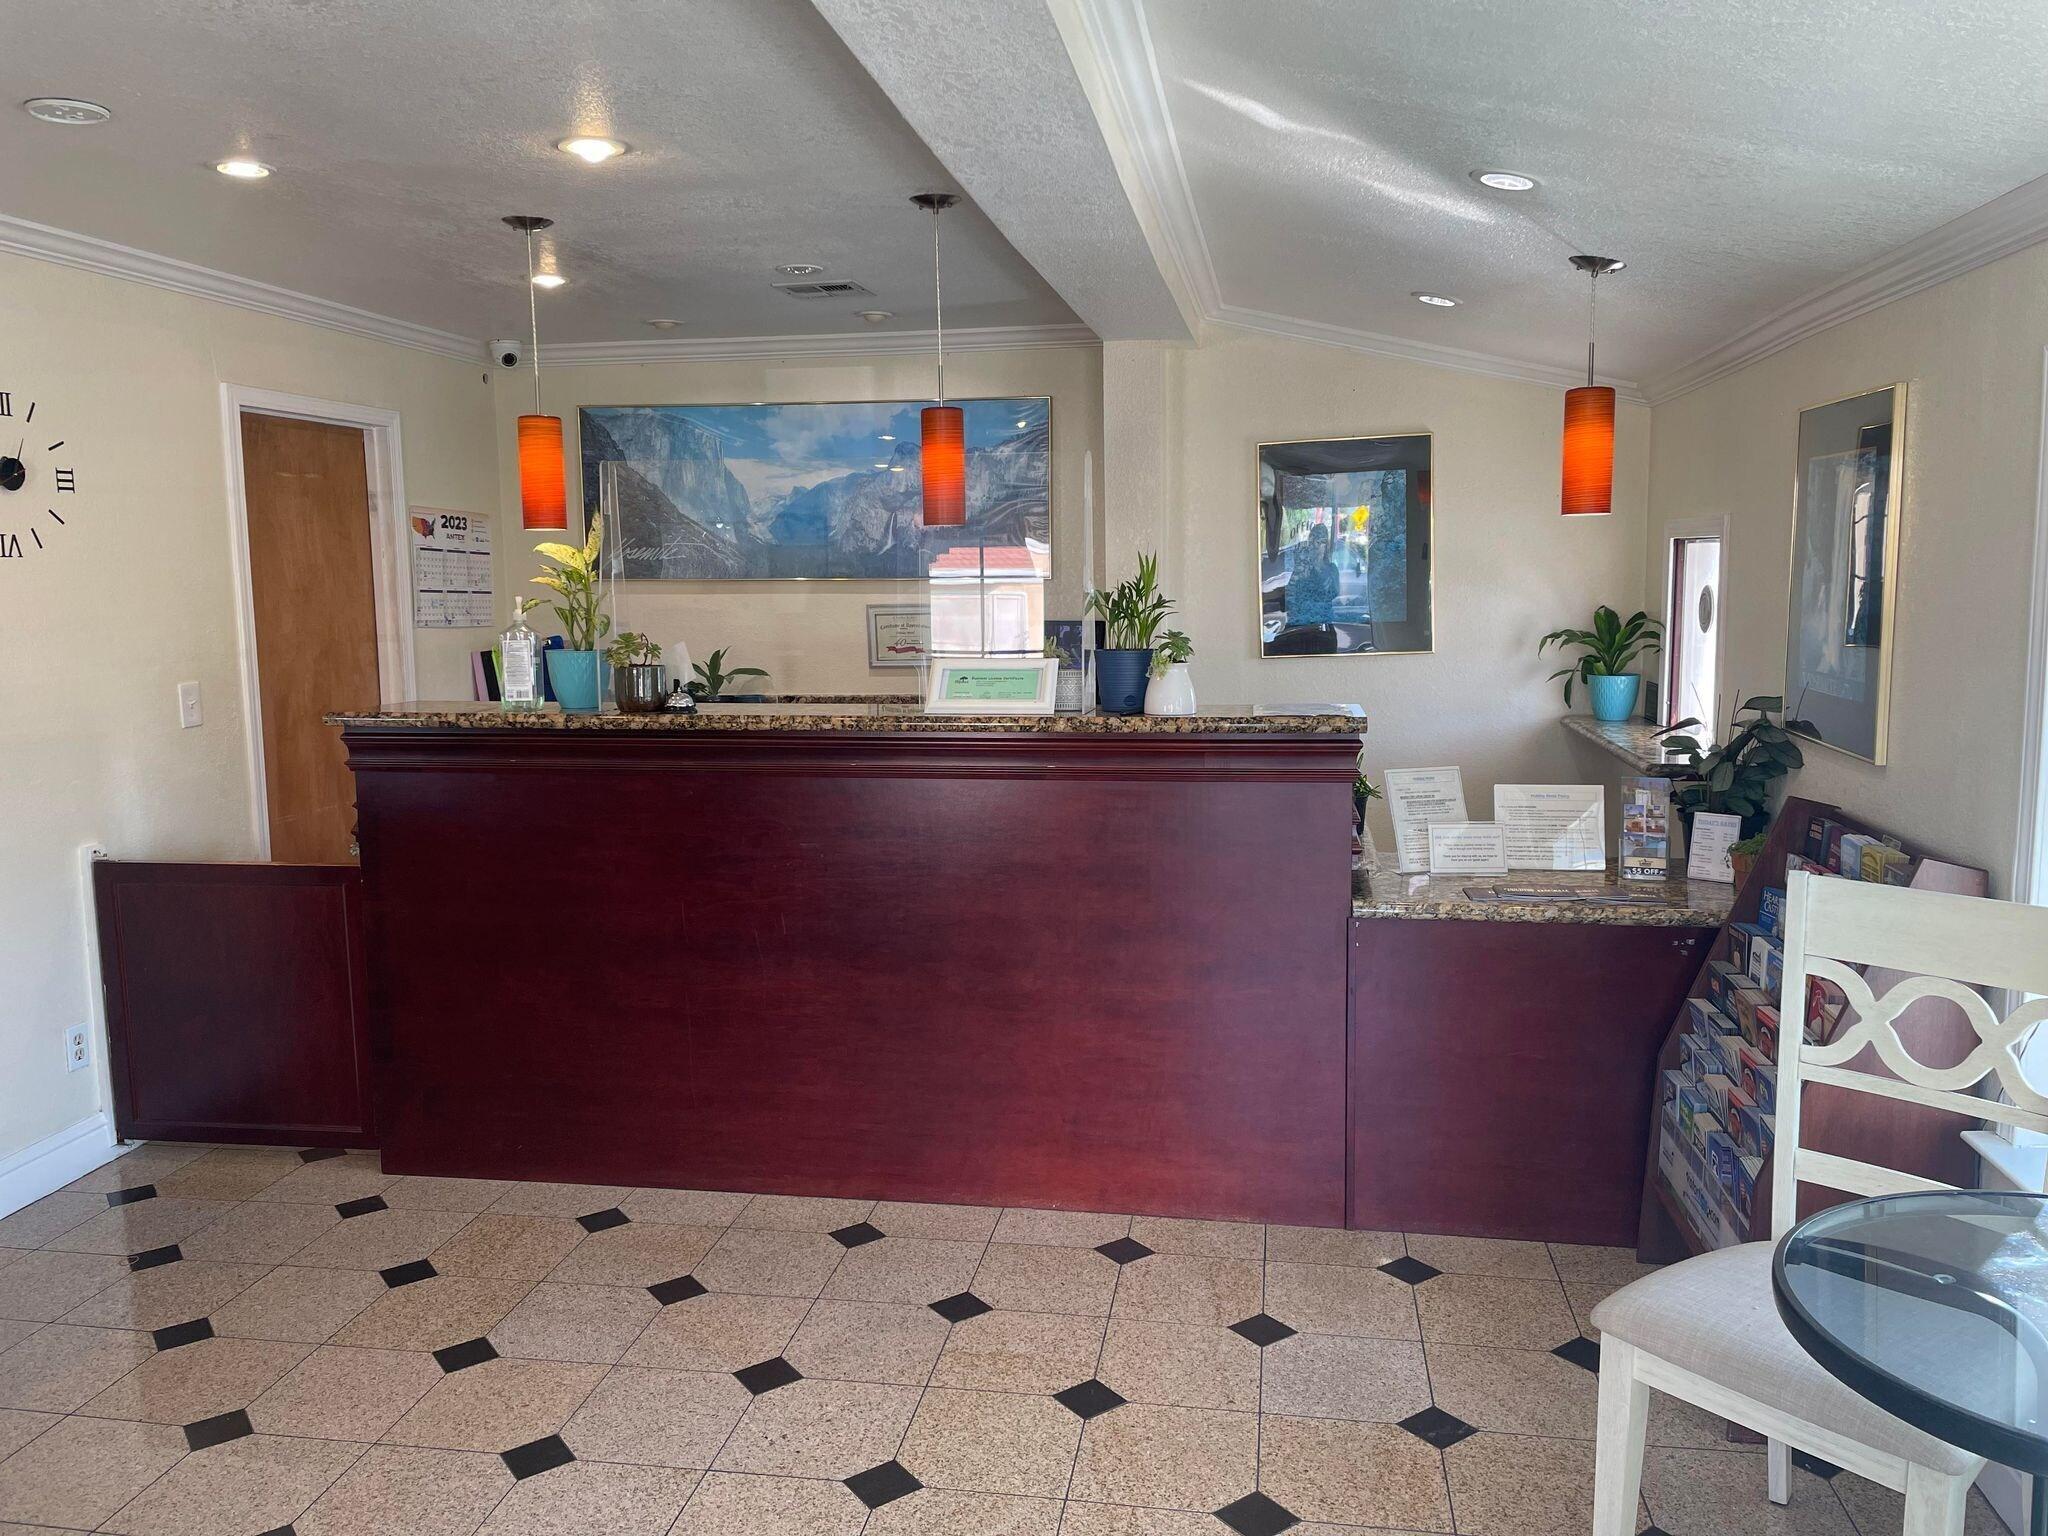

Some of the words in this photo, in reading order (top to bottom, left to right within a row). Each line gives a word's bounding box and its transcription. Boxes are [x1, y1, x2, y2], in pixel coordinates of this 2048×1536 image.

[55, 467, 76, 494] III
[440, 514, 468, 531] 2023
[1643, 868, 1660, 876] OFF
